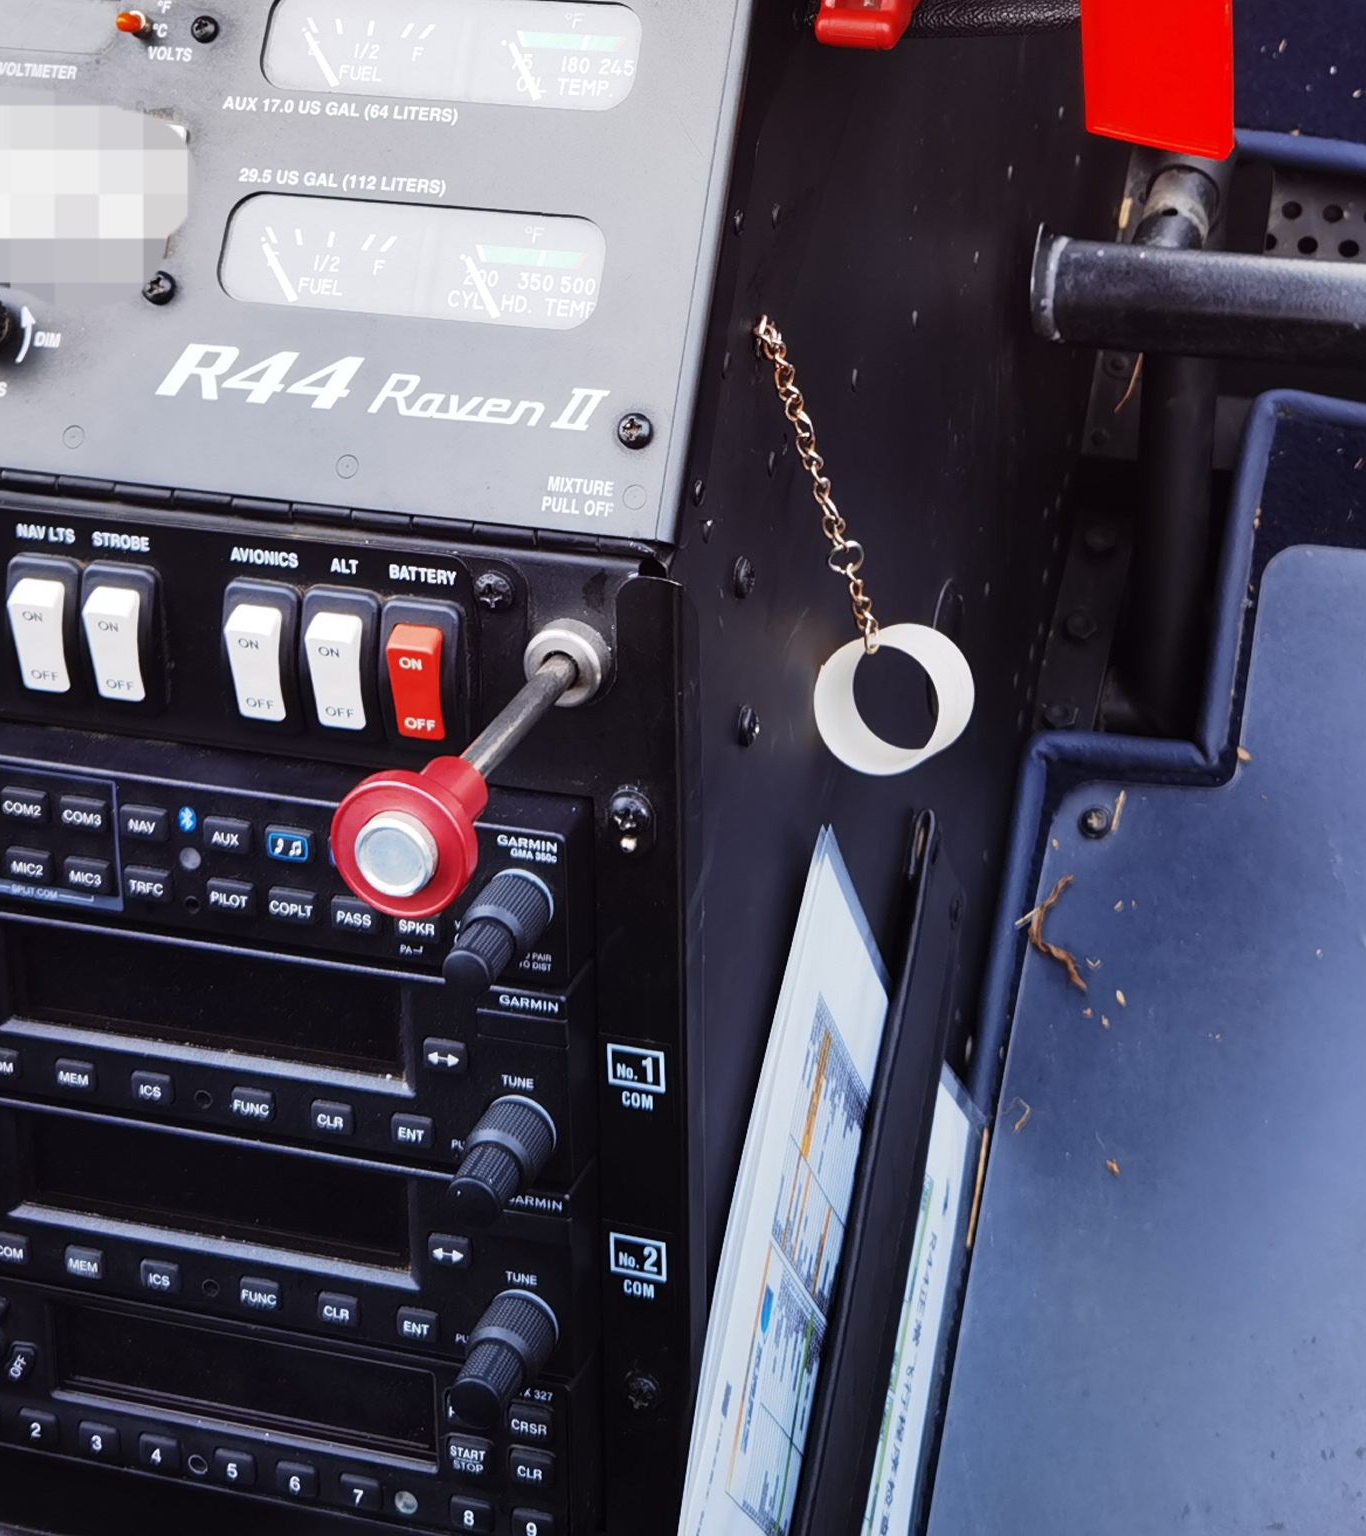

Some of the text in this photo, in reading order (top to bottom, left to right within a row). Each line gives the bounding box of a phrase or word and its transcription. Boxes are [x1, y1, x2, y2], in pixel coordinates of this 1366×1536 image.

[147, 47, 192, 62] VOLTS
[223, 96, 458, 125] AUX 17.0 US GAL (64 LITERS)
[239, 168, 446, 197] 29.5 US GAL (112 LITERS)
[34, 332, 61, 348] DIM
[155, 343, 610, 431] R44 Raven II
[548, 476, 614, 496] MIXTURE
[542, 497, 614, 517] PULL OFF
[16, 523, 75, 544] NAV LTS
[92, 531, 149, 552] STROBE
[231, 547, 298, 568] AVIONICS
[331, 558, 358, 574] ALT
[389, 564, 456, 586] BATTERY
[400, 657, 423, 670] ON
[404, 717, 436, 731] OFF
[2, 801, 41, 817] COM2
[62, 810, 102, 826] COM3
[129, 819, 156, 834] NAV
[211, 831, 239, 847] AUX
[497, 834, 558, 853] GARMIN
[11, 860, 43, 875] MIC2
[70, 870, 102, 886] MIC3
[129, 880, 163, 895] TRFC
[210, 891, 248, 908] PILOT
[269, 900, 313, 917] COPLT
[336, 911, 371, 927] PASS
[398, 919, 435, 935] SPKR
[499, 995, 559, 1013] GARMIN
[616, 1057, 653, 1083] No. 1
[59, 1071, 89, 1086] MEM
[502, 1074, 534, 1090] TUNE
[233, 1100, 269, 1117] FUNC
[622, 1091, 653, 1111] COM
[317, 1114, 343, 1130] CLR
[397, 1127, 424, 1143] ENT
[619, 1247, 658, 1272] No. 2
[624, 1280, 655, 1299] COM
[511, 1419, 547, 1436] CRSR
[450, 1445, 486, 1460] START
